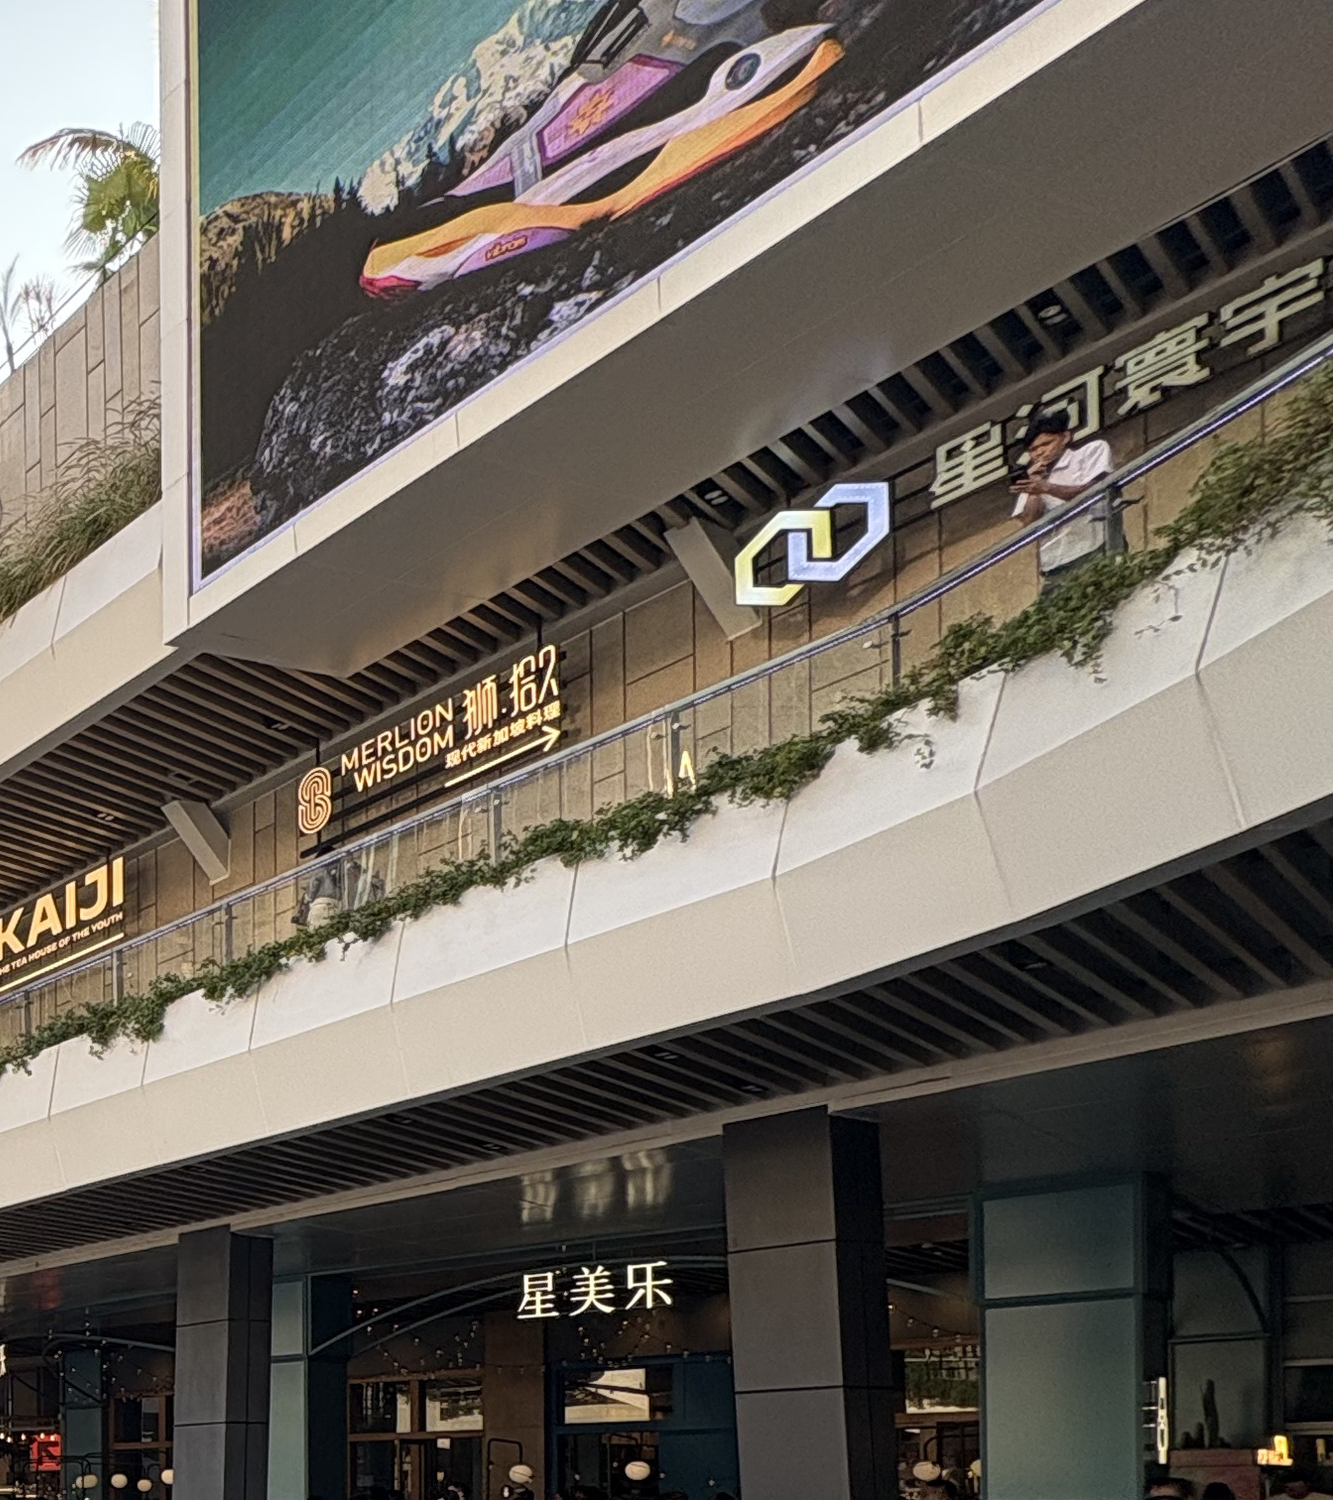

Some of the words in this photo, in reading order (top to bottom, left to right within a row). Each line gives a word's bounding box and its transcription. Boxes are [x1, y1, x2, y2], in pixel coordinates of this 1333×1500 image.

[928, 256, 1325, 510] 星河寰宇
[340, 697, 454, 777] MERLION
[353, 724, 454, 793] WISDOM
[444, 700, 561, 770] 现代新加坡料理
[11, 957, 28, 970] TEA
[28, 943, 58, 963] HOUSE
[58, 936, 71, 948] OF
[72, 926, 90, 942] THE
[90, 911, 124, 934] YOUTH
[516, 1260, 674, 1320] 星美乐
